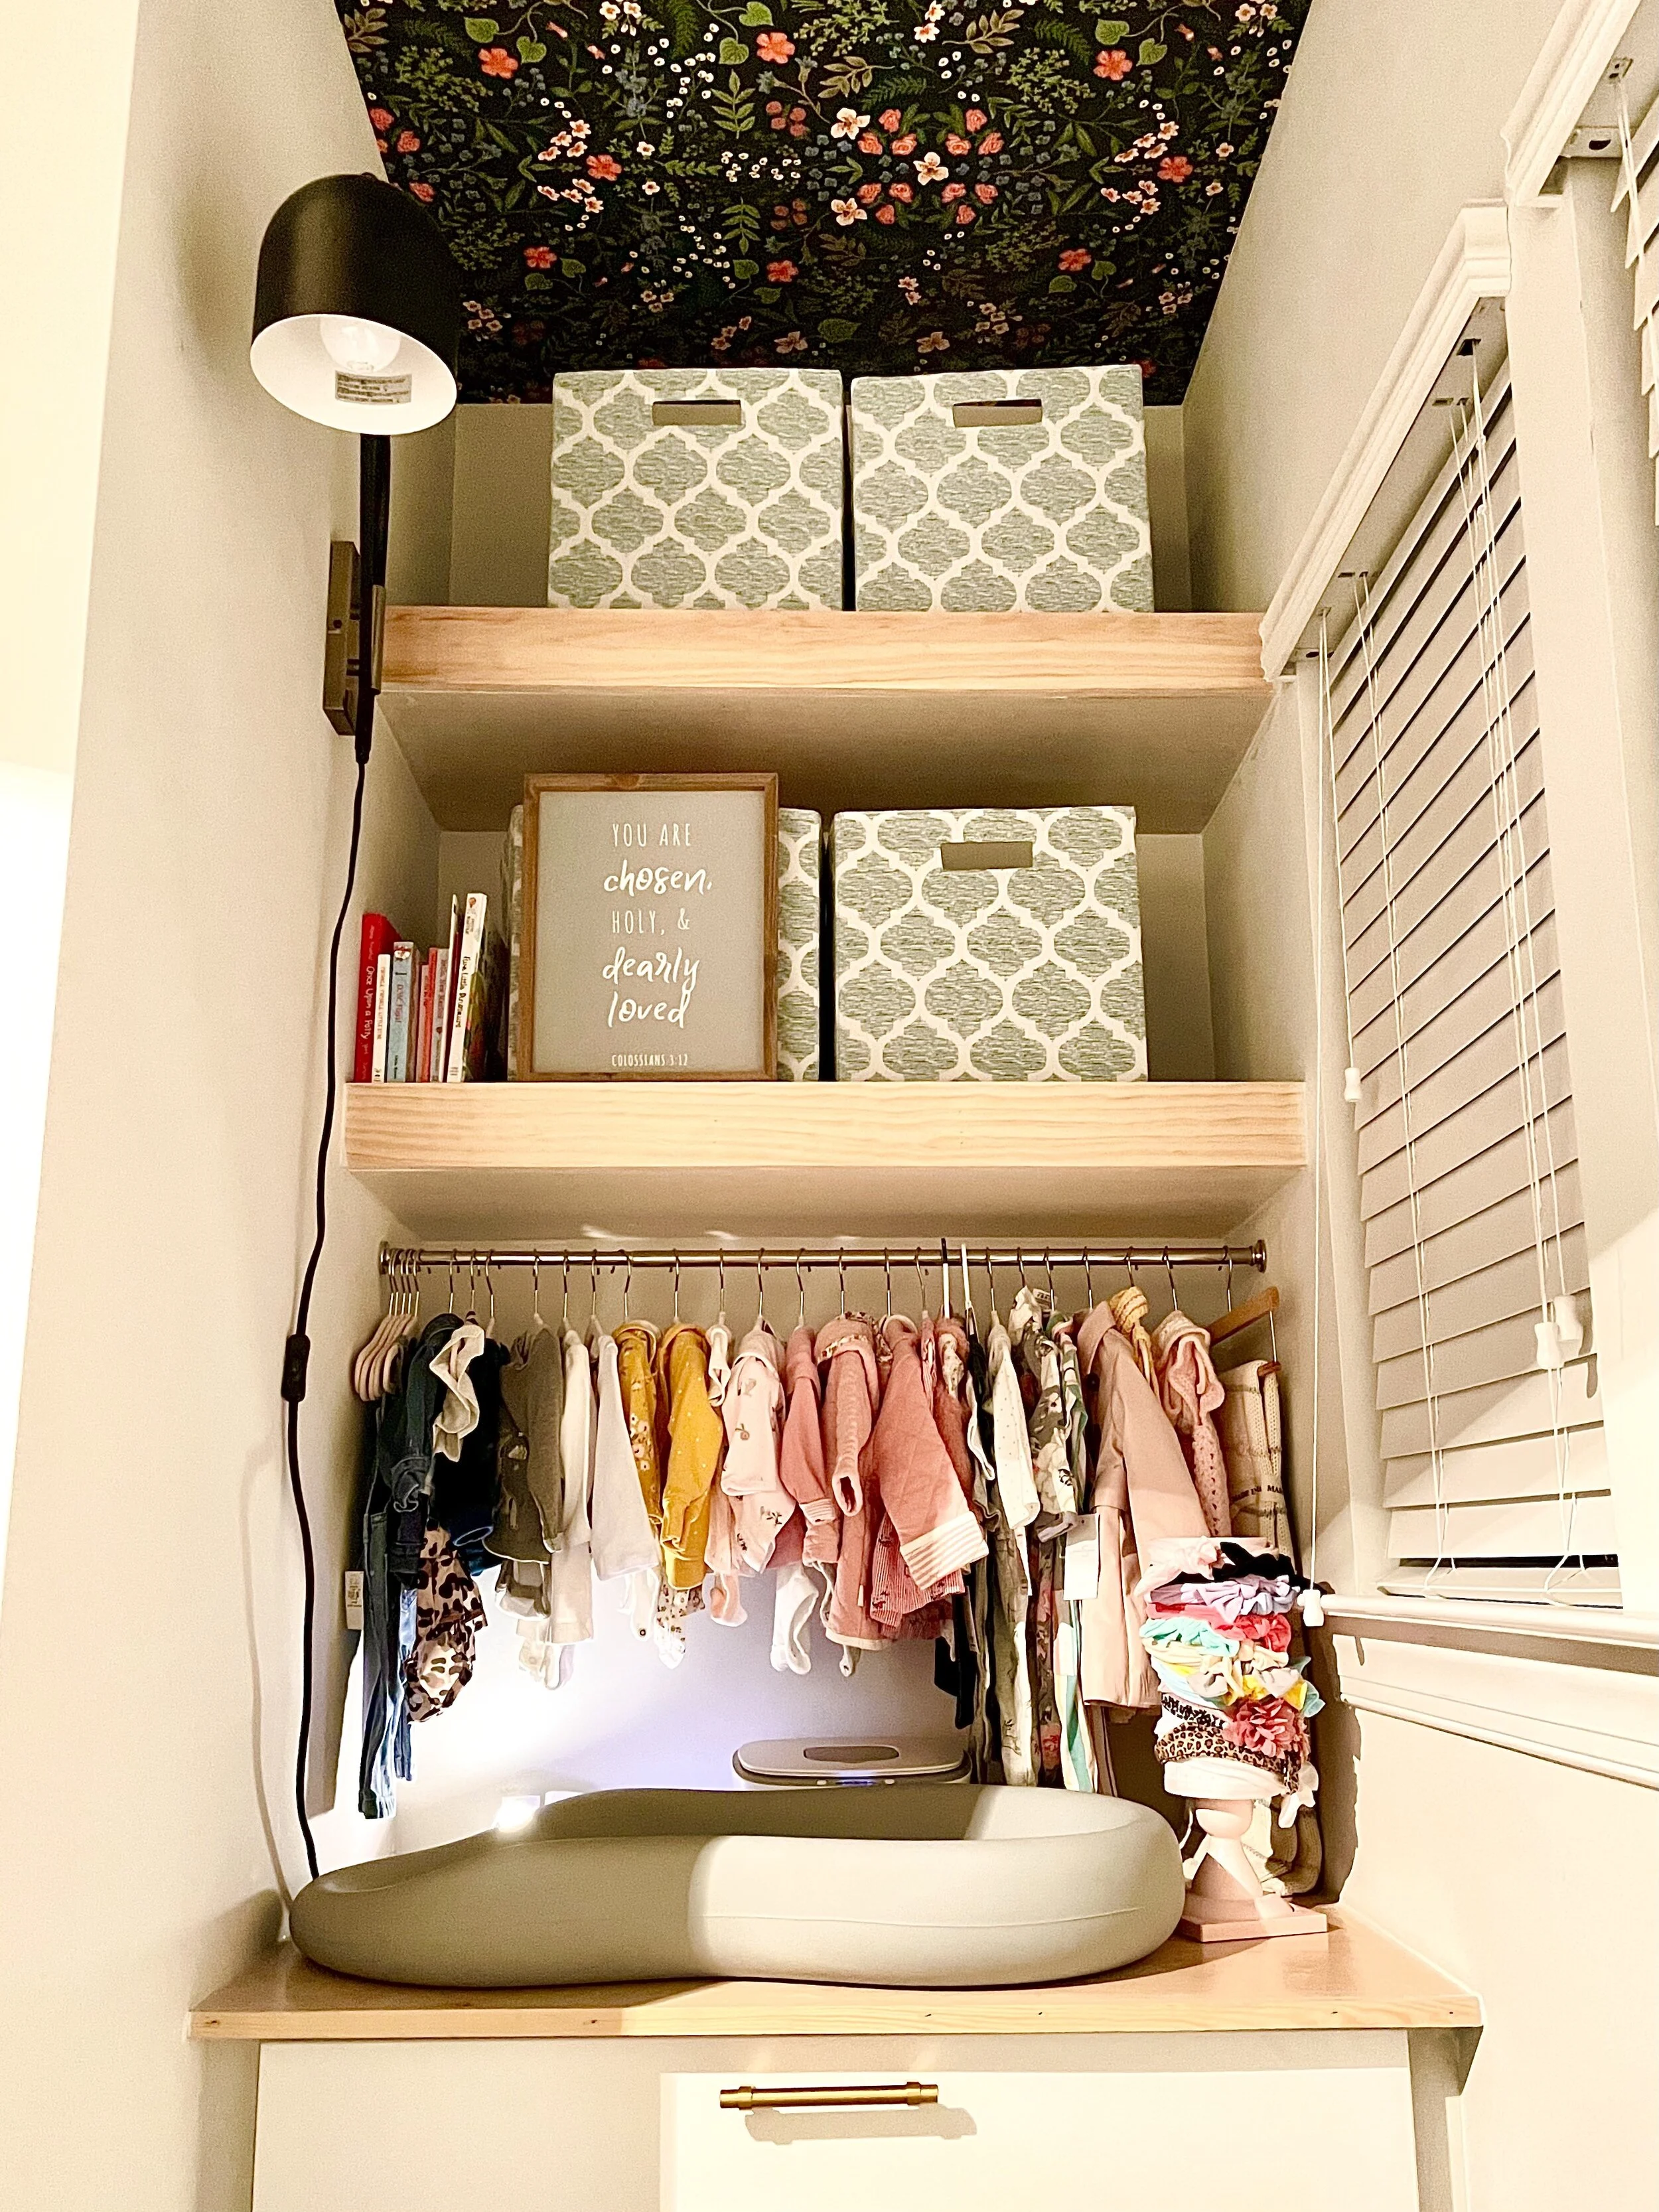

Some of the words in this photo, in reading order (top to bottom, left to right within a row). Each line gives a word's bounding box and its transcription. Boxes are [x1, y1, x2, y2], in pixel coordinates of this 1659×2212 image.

[612, 823, 648, 847] YOU
[659, 823, 692, 847] ARE
[611, 909, 665, 936] HOLY,
[677, 907, 691, 930] &
[366, 966, 376, 986] Once
[602, 946, 701, 994] dearly
[363, 988, 374, 1009] Upon
[607, 990, 692, 1028] loved
[360, 1019, 373, 1040] Potty
[611, 1054, 666, 1067] COLOSSIANS
